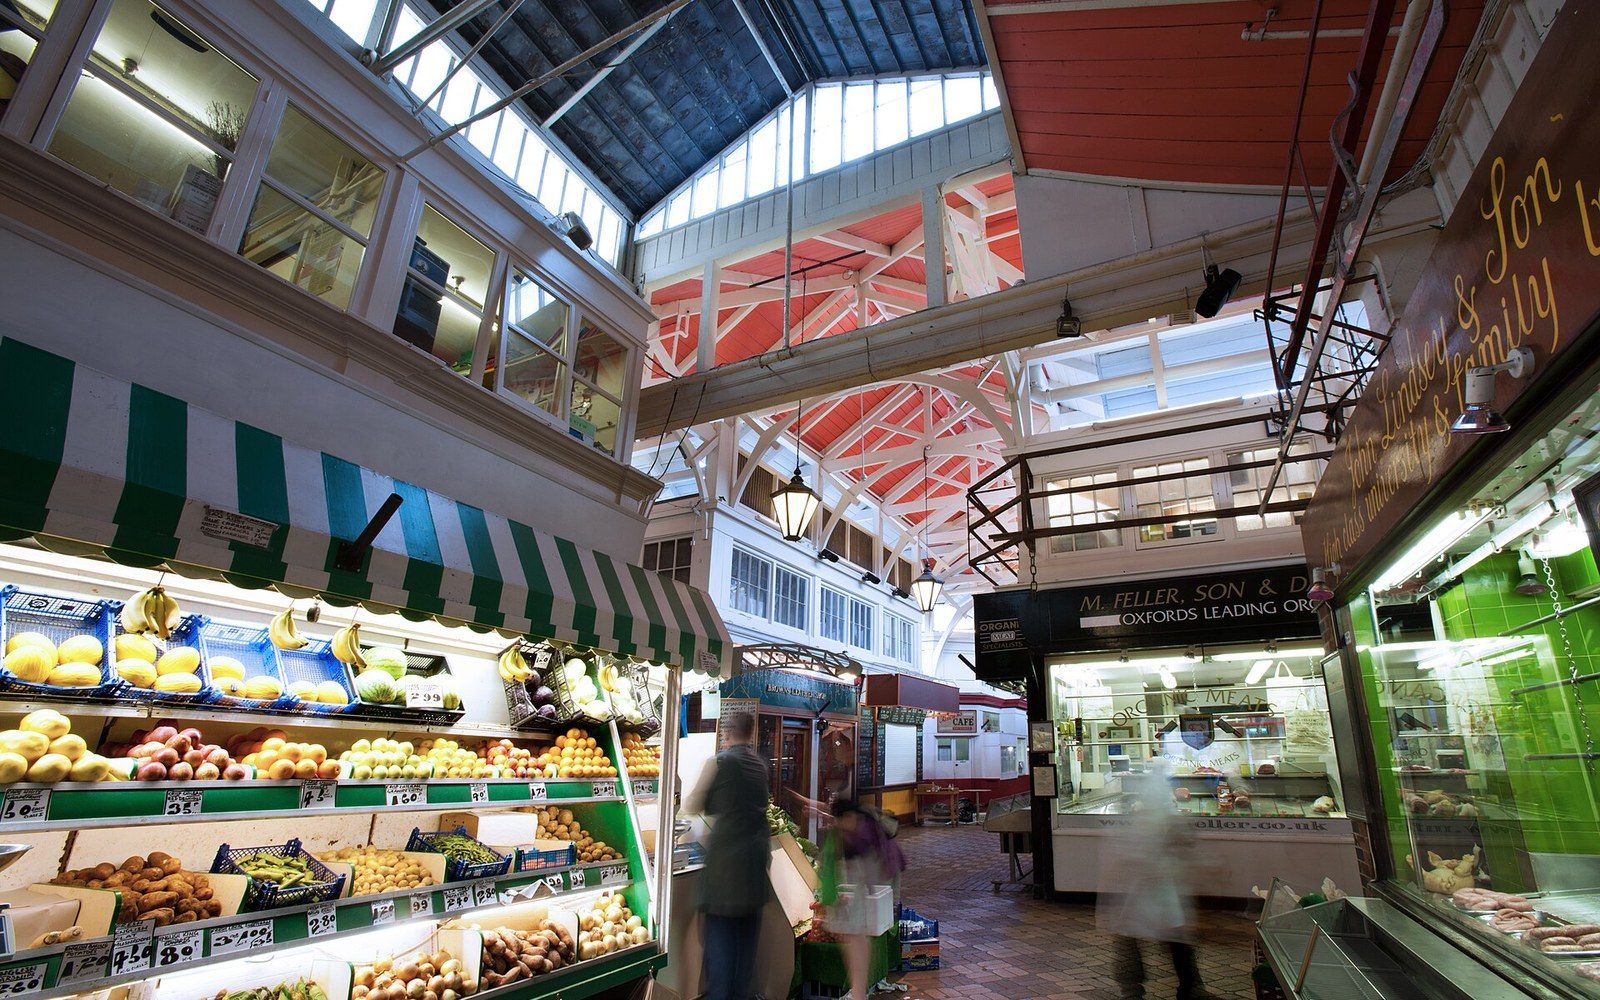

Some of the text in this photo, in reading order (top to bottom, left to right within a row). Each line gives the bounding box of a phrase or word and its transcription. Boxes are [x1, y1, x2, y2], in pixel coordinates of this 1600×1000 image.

[1345, 156, 1562, 510] John Lindsey & Son
[1434, 394, 1451, 448] &
[1080, 576, 1312, 611] M. FELLER, SON & D
[1122, 607, 1198, 626] OXFORDS
[1204, 600, 1277, 620] LEADING
[1112, 688, 1279, 727] ORGNIC MEATS
[1209, 752, 1240, 768] MEATS
[159, 945, 194, 967] 80
